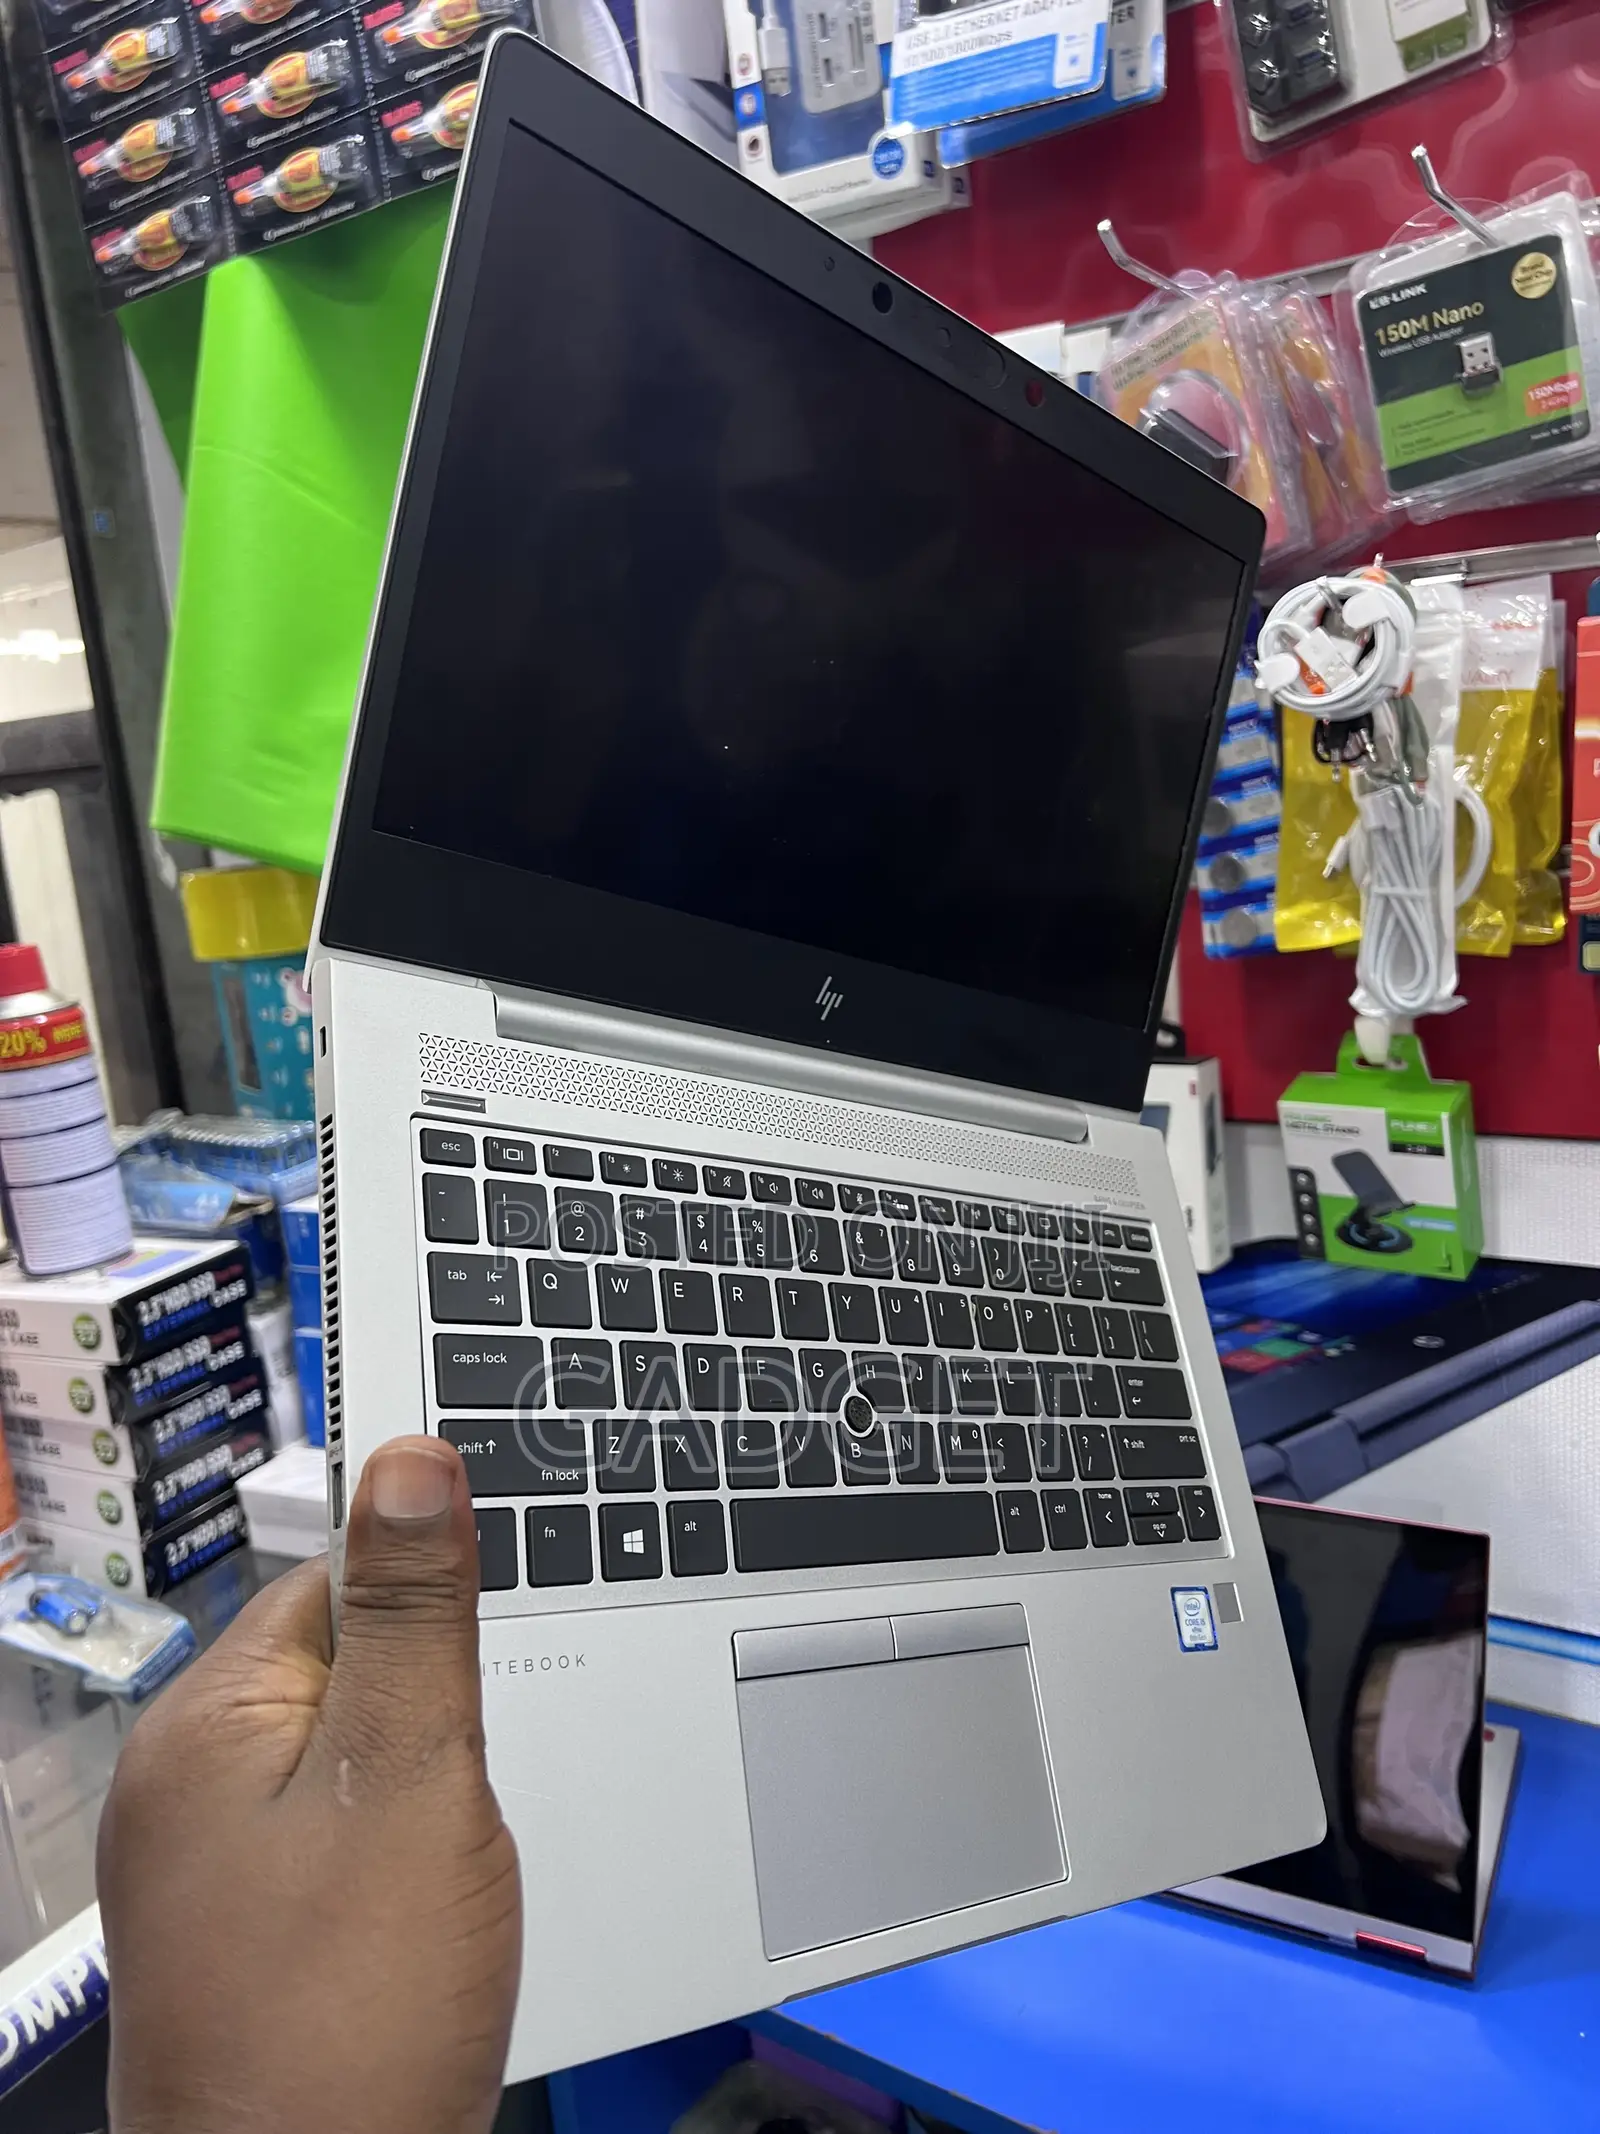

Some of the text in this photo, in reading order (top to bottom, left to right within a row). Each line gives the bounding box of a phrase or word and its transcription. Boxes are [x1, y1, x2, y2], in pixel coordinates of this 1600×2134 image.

[1374, 301, 1485, 346] 150M Nano
[441, 1141, 461, 1151] esc
[570, 1200, 586, 1217] @
[635, 1207, 645, 1220] #
[503, 1219, 510, 1235] 1
[696, 1214, 706, 1230] $
[752, 1219, 764, 1233] %
[574, 1226, 585, 1241] 2
[637, 1231, 648, 1246] 3
[855, 1231, 865, 1245] &
[698, 1238, 709, 1253] 4
[756, 1243, 765, 1258] 5
[809, 1249, 819, 1263] 6
[858, 1253, 866, 1267] 7
[907, 1258, 916, 1272] 8
[952, 1263, 961, 1276] 9
[447, 1268, 468, 1281] tab
[542, 1272, 559, 1291] Q
[995, 1268, 1005, 1281] 0
[611, 1277, 630, 1295] W
[673, 1282, 685, 1298] E
[732, 1286, 744, 1302] R
[788, 1290, 798, 1306] T
[841, 1295, 852, 1310] Y
[890, 1299, 901, 1313] U
[983, 1306, 994, 1320] O
[1024, 1309, 1033, 1323] P
[452, 1351, 508, 1366] caps lock
[568, 1353, 583, 1371] A
[635, 1355, 646, 1373] S
[698, 1357, 710, 1374] D
[756, 1360, 766, 1376] F
[812, 1362, 824, 1378] G
[865, 1363, 876, 1379] H
[915, 1366, 923, 1381] J
[961, 1368, 972, 1383] K
[1005, 1370, 1014, 1385] L
[457, 1442, 483, 1455] shift
[608, 1436, 620, 1454] Z
[674, 1436, 687, 1454] X
[736, 1435, 748, 1453] C
[794, 1435, 806, 1452] V
[850, 1442, 862, 1458] B
[901, 1435, 912, 1451] N
[950, 1435, 962, 1450] M
[1131, 1440, 1146, 1449] shift
[541, 1469, 579, 1481] fn lock
[1010, 1506, 1020, 1516] alt
[1054, 1504, 1067, 1514] ctrl
[544, 1526, 556, 1538] fn
[684, 1520, 697, 1532] alt
[483, 1653, 587, 1677] ITEBOOK
